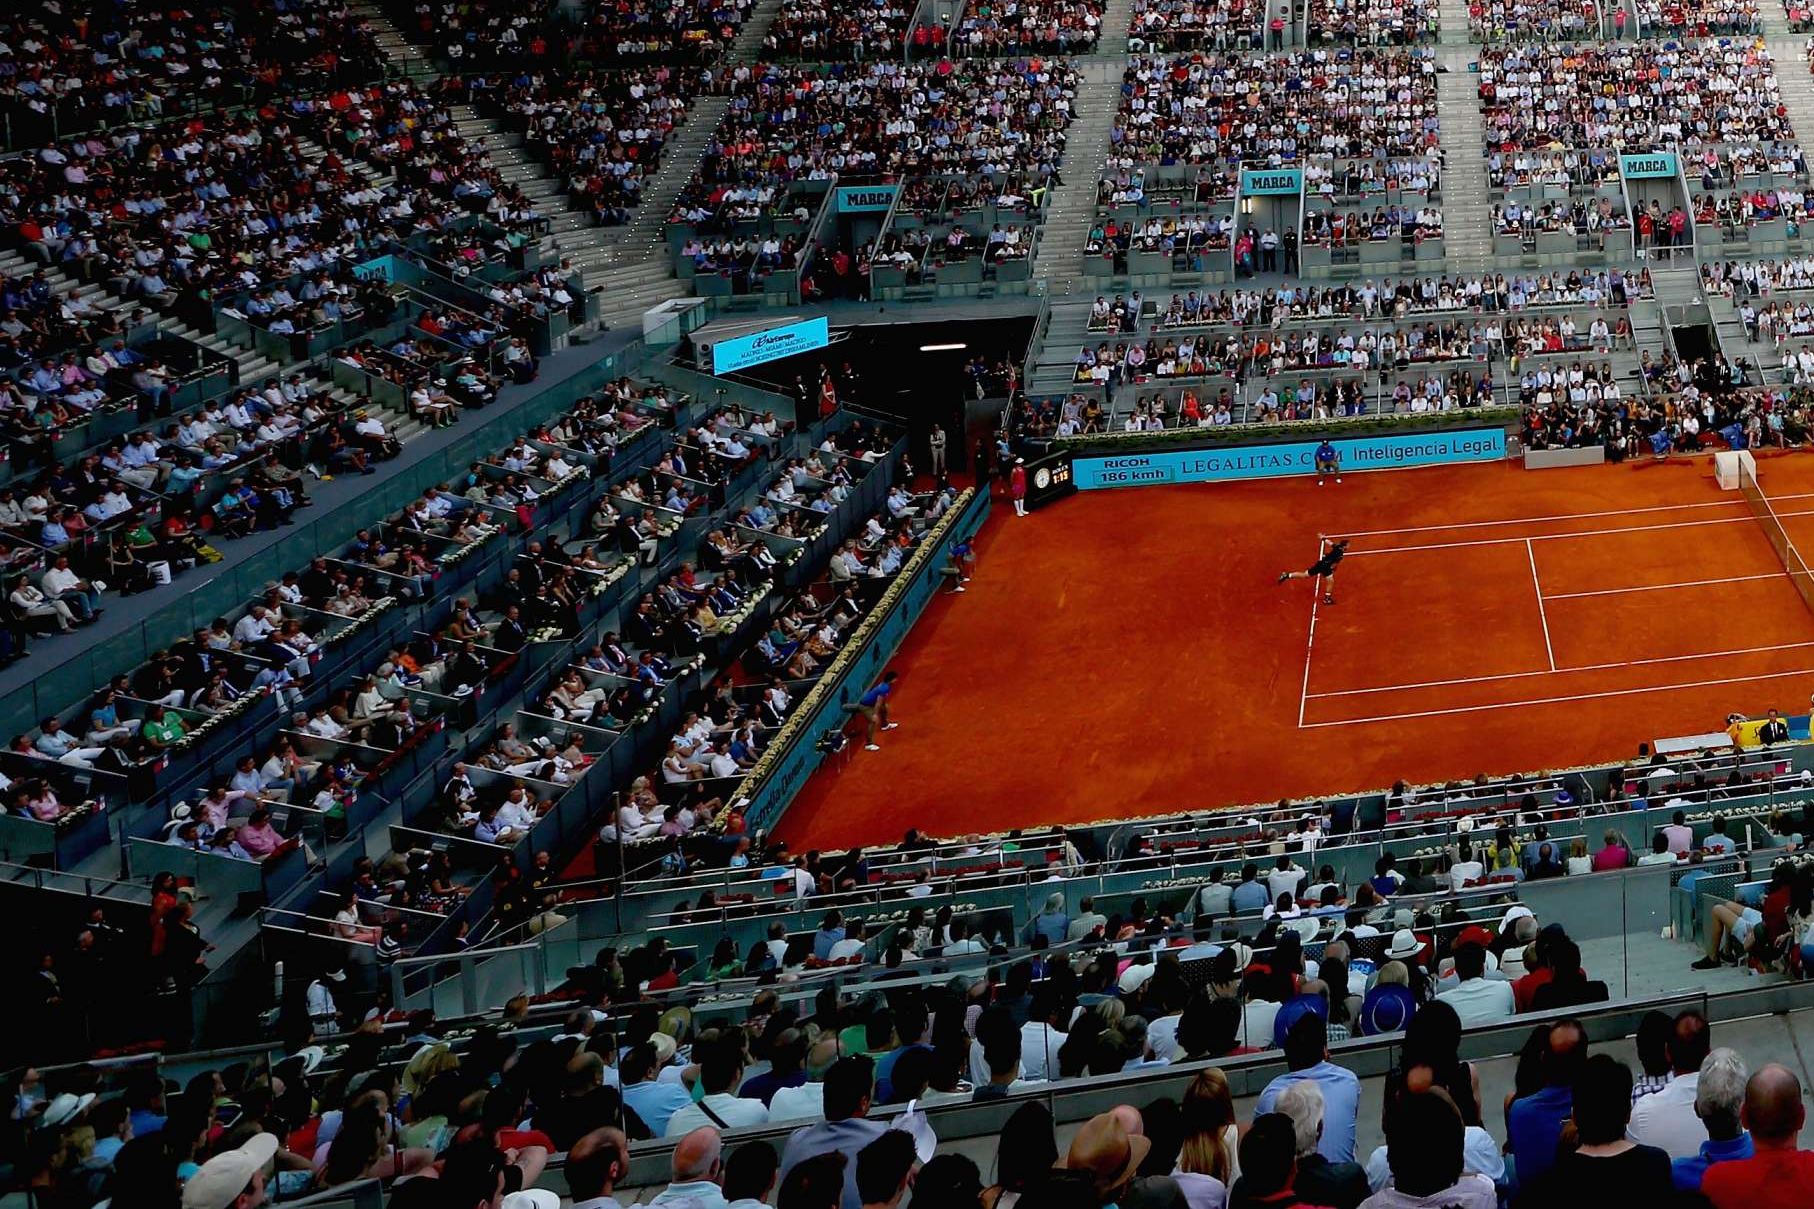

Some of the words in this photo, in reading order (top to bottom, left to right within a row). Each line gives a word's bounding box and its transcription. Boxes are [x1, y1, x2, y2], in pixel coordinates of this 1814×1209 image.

[1627, 160, 1667, 173] MARCA
[1251, 176, 1295, 190] MARCA
[847, 192, 893, 207] MARCA
[1354, 441, 1448, 462] Inteligencia
[1452, 438, 1501, 454] Legal.
[1104, 458, 1150, 469] RICOH
[1053, 470, 1069, 484] 1:15
[1101, 471, 1128, 482] 186
[1132, 470, 1165, 480] kmh
